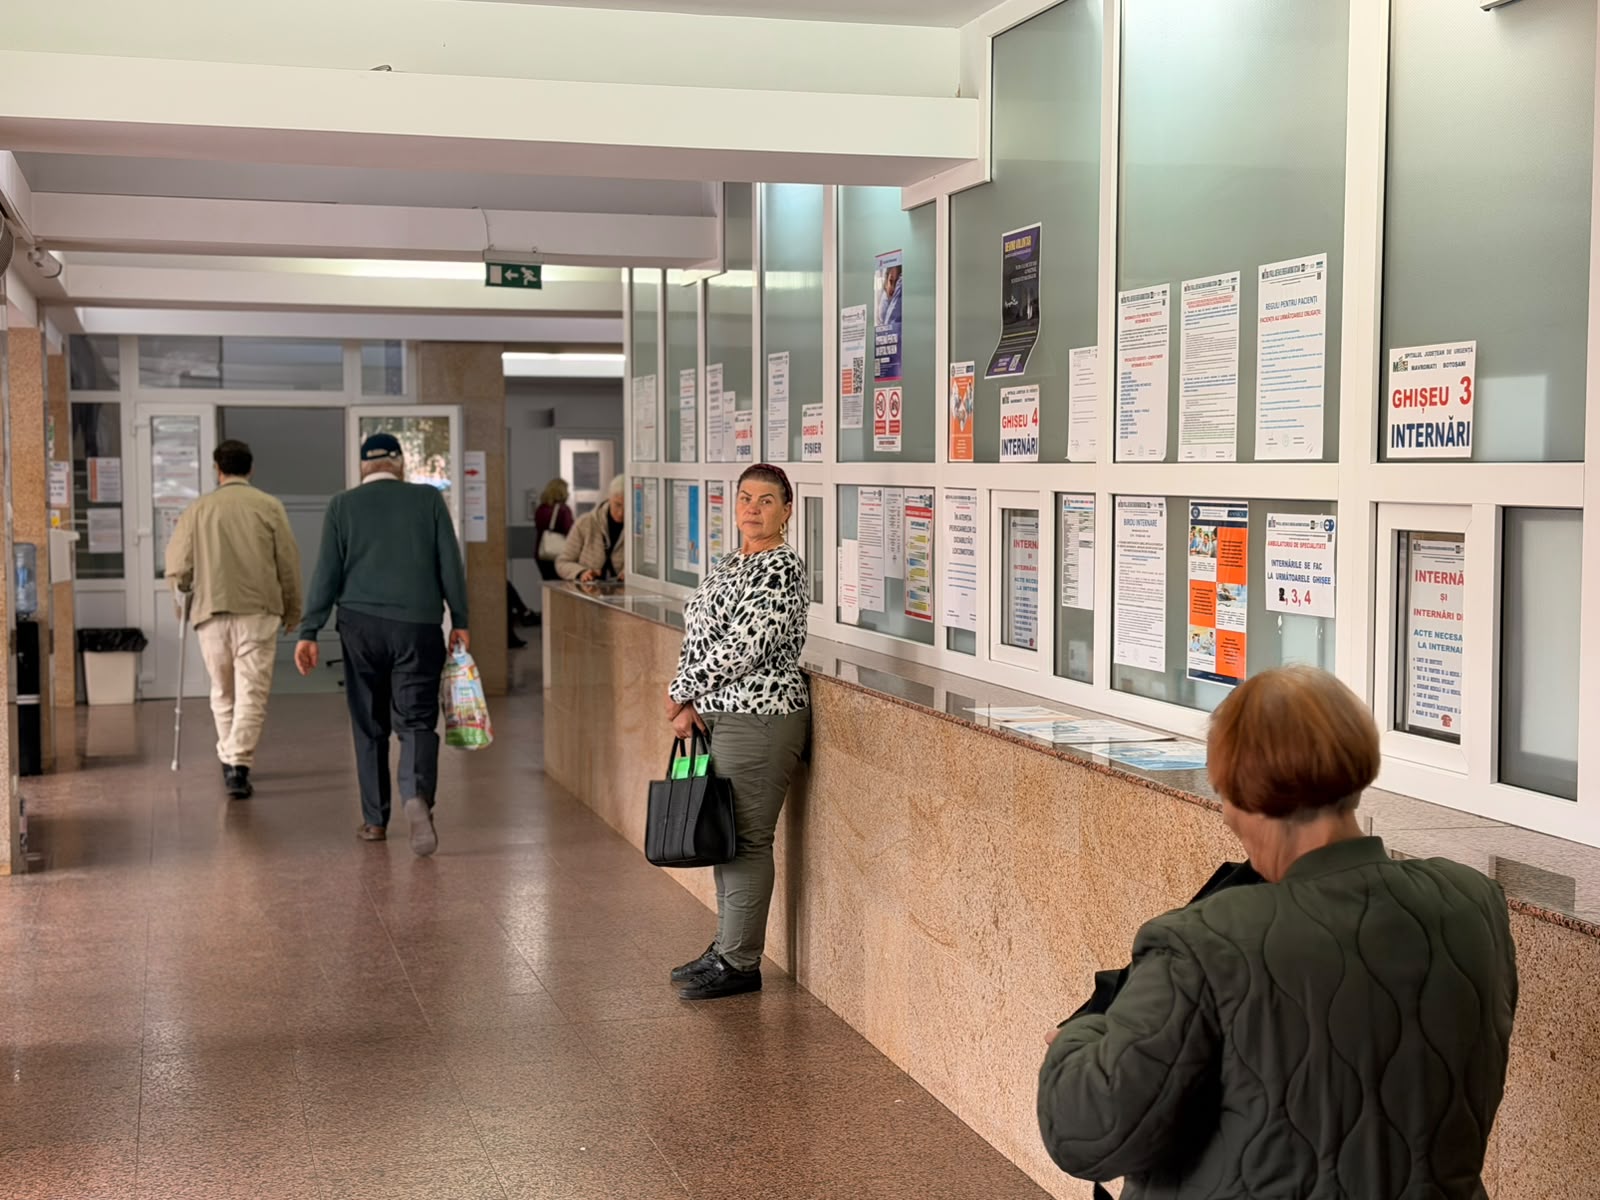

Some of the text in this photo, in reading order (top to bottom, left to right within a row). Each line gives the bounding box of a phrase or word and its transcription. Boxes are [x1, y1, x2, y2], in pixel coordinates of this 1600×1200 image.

[1281, 298, 1297, 307] PENTRU
[1392, 376, 1472, 414] GHIȘEU 3
[1002, 408, 1038, 432] GHIȘEU 4
[1391, 415, 1470, 448] INTERNĂRI
[1002, 434, 1037, 456] INTERNĂRI
[1271, 559, 1302, 569] INTERNĂRILE
[1276, 572, 1310, 583] URMĂTOARELE
[1312, 576, 1331, 586] GHIȘEE
[1291, 588, 1301, 607] 3,
[1304, 590, 1311, 605] 4
[1440, 593, 1448, 602] ȘI
[1414, 608, 1454, 620] INTERNĂRI
[1414, 629, 1432, 638] ACTE
